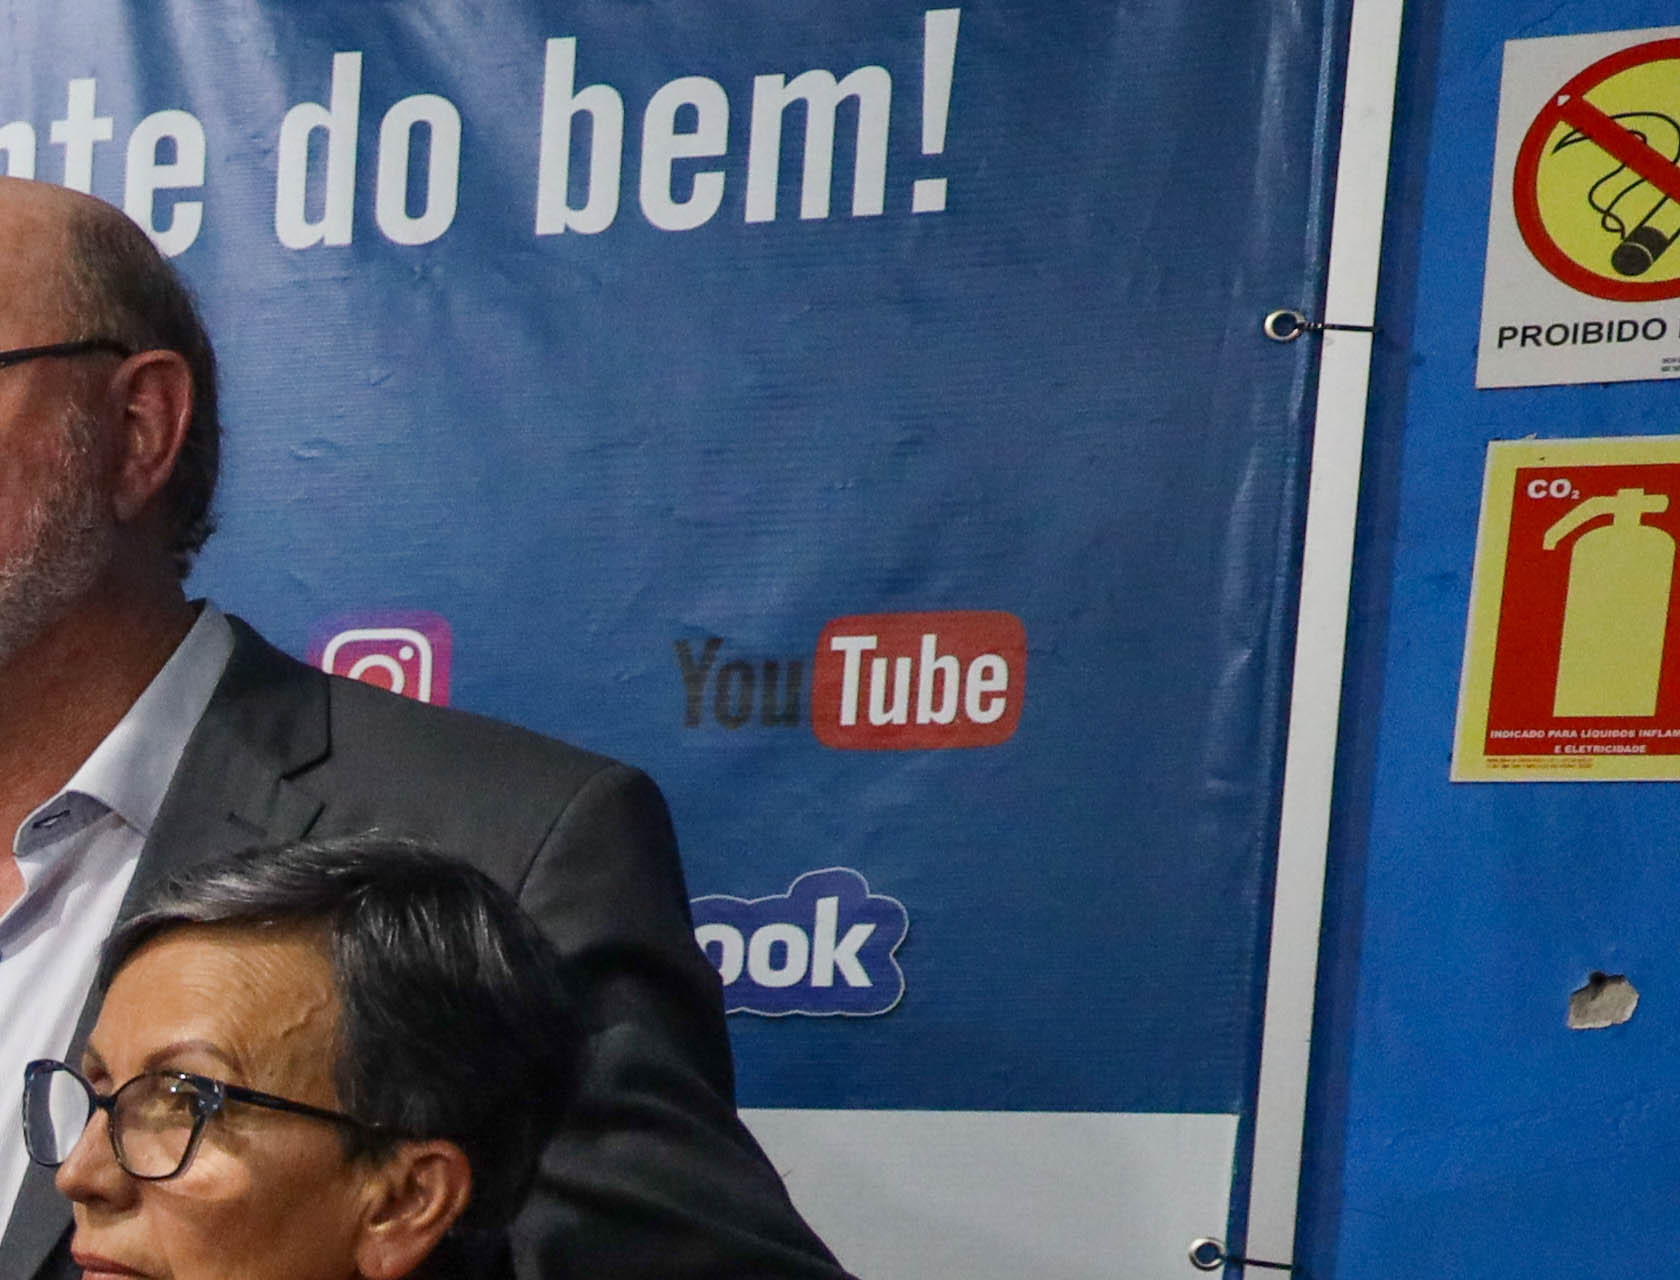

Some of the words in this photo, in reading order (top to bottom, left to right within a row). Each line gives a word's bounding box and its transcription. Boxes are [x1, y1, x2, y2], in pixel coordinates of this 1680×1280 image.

[275, 51, 461, 250] do
[535, 8, 960, 236] bem!
[1497, 317, 1667, 349] PROIBIDO
[672, 634, 1009, 731] YouTube
[1489, 729, 1545, 739] INDICADO
[1547, 729, 1578, 739] PARA
[1564, 744, 1648, 754] ELETRICIDADE
